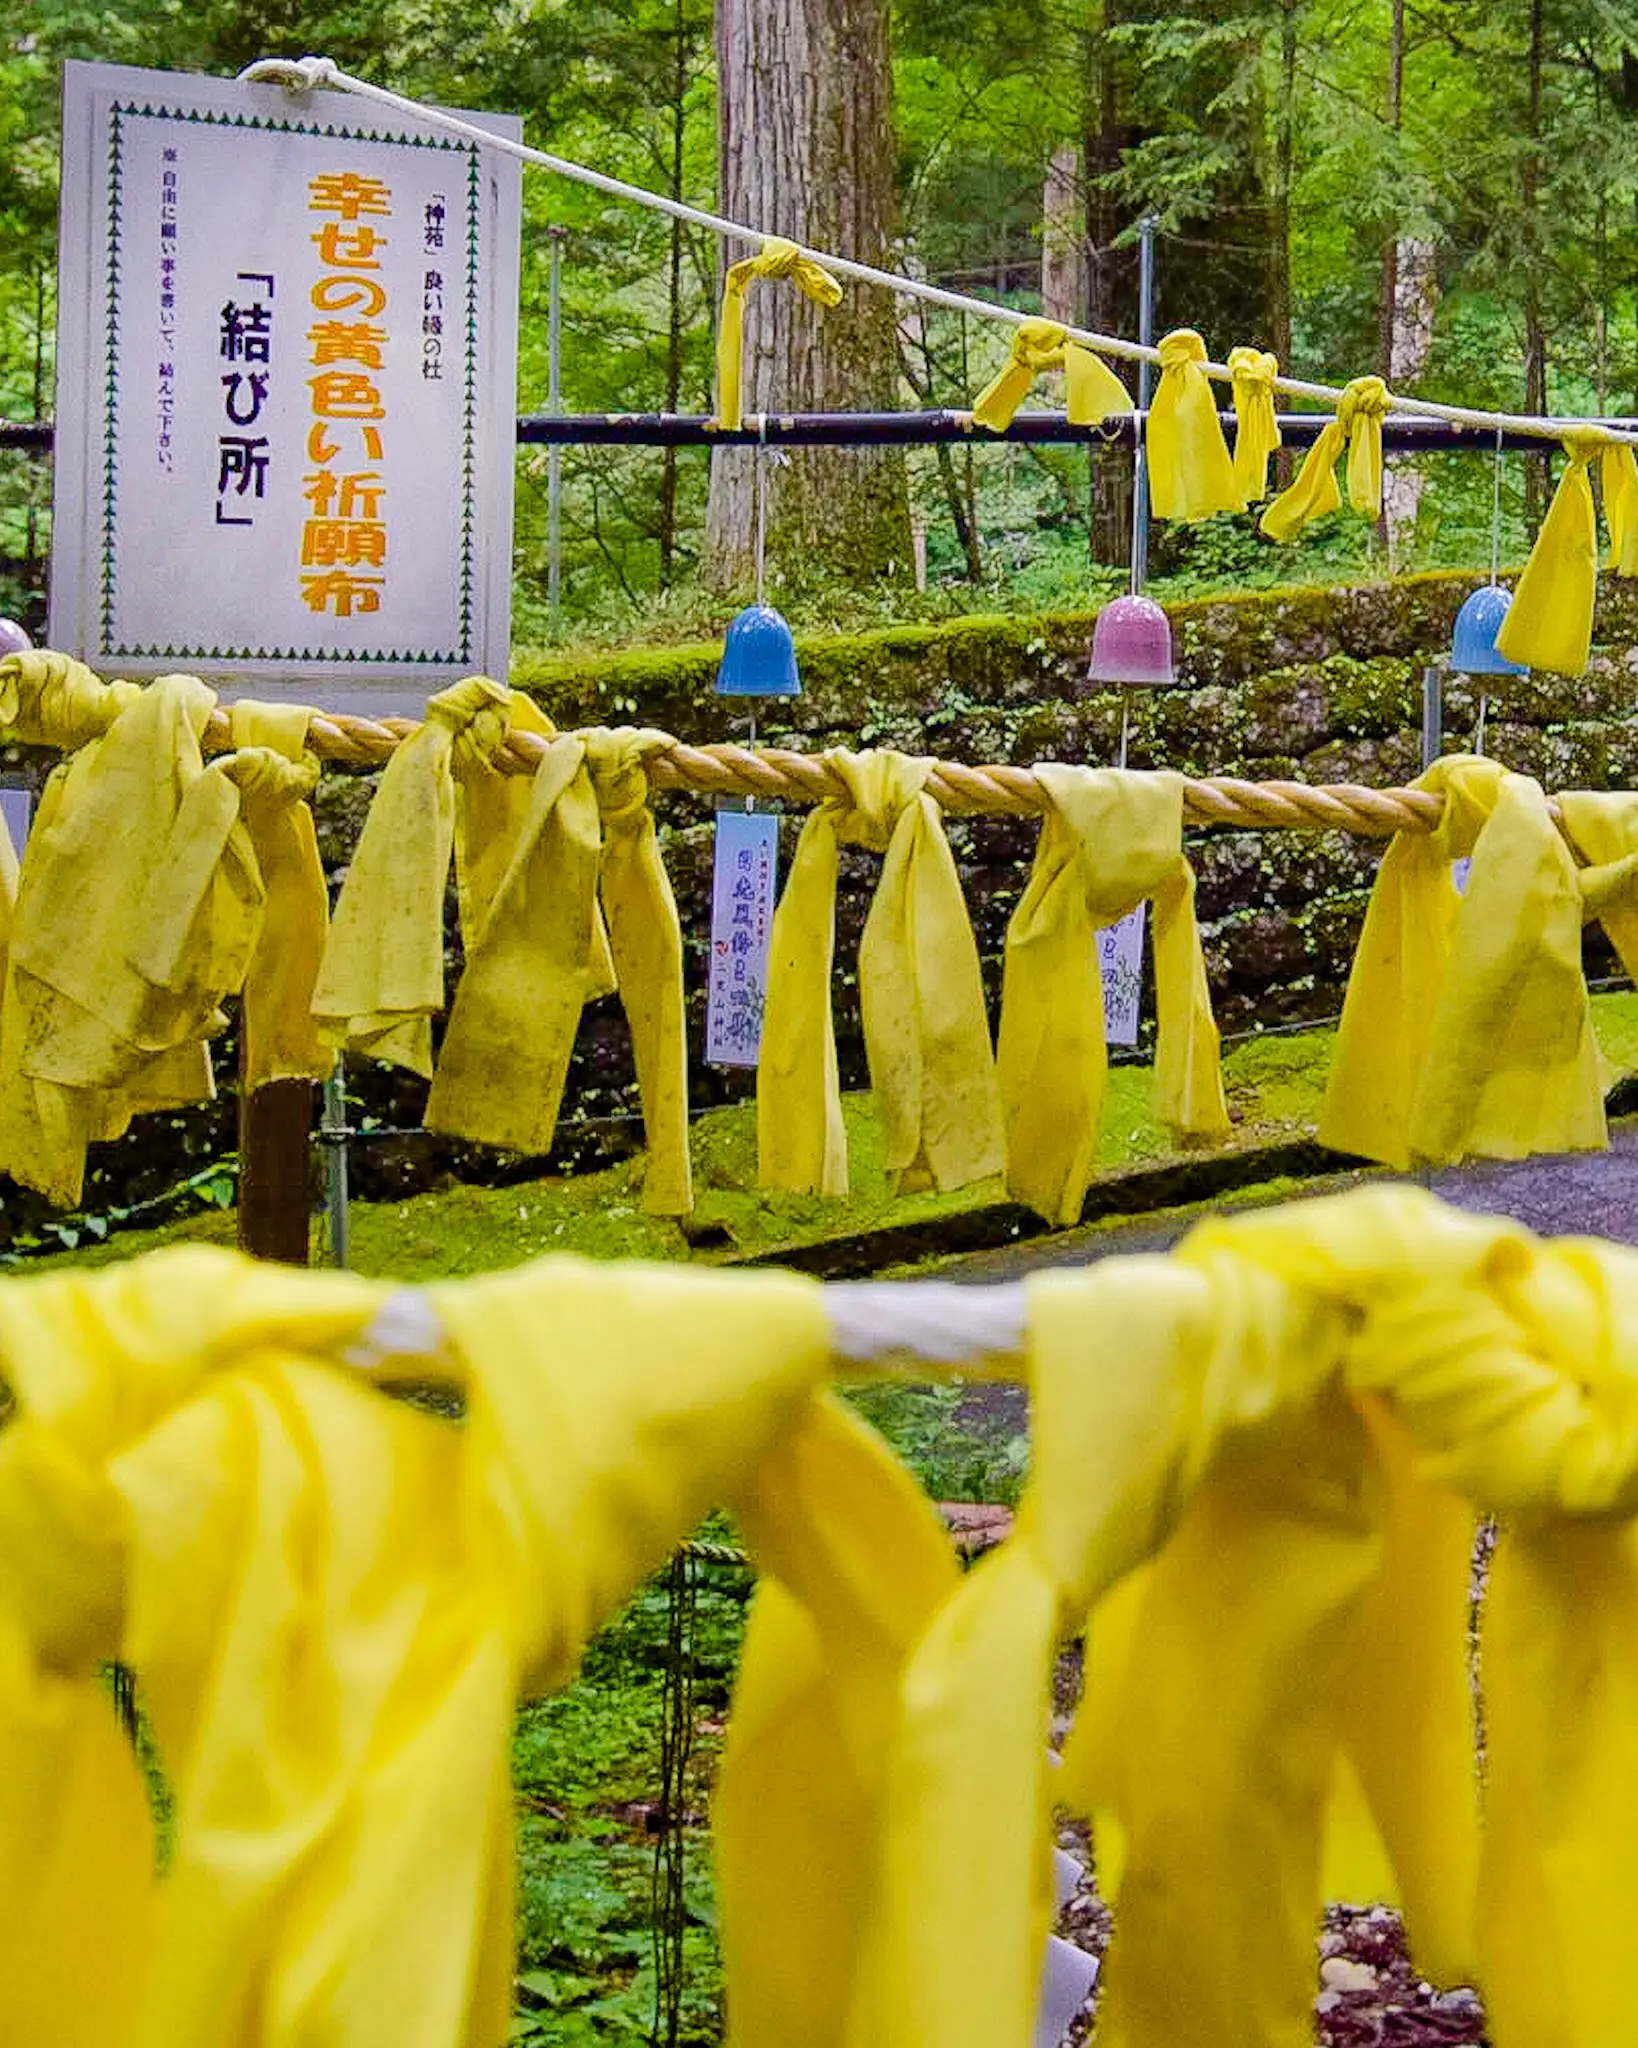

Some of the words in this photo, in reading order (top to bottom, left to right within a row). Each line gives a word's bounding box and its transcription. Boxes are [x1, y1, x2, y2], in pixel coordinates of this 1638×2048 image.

[215, 271, 275, 526] 「結び所」
[300, 172, 392, 617] 幸せの黄色い祈願布
